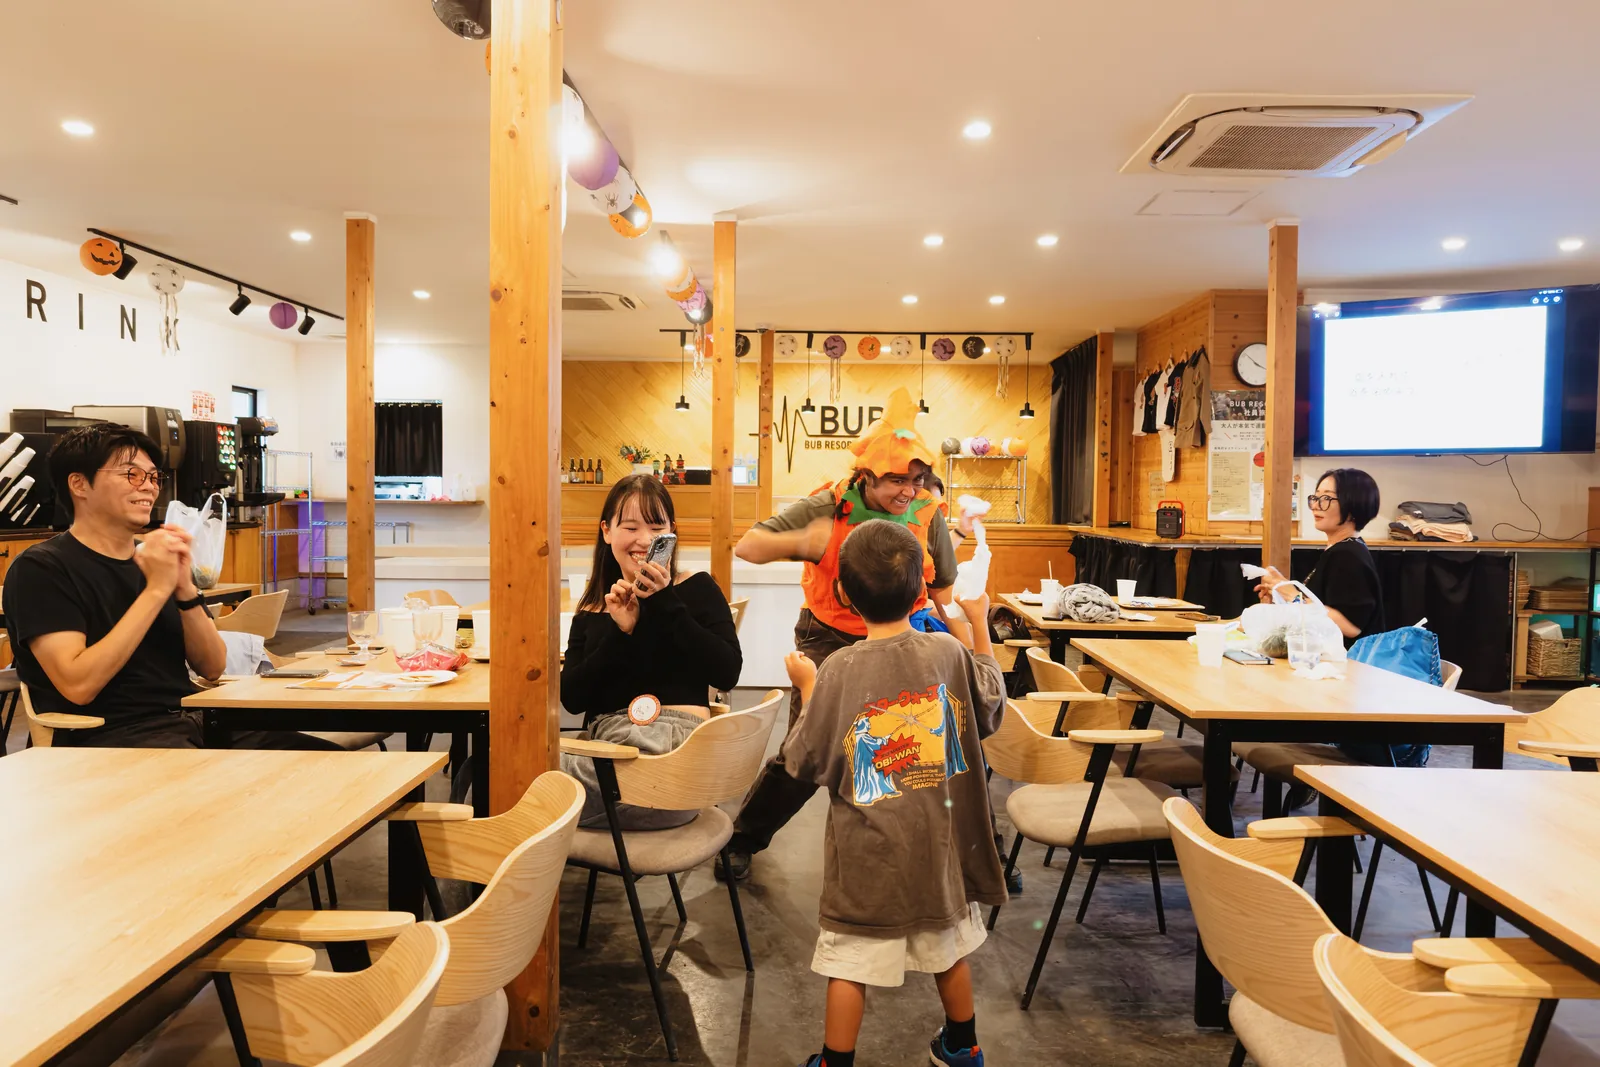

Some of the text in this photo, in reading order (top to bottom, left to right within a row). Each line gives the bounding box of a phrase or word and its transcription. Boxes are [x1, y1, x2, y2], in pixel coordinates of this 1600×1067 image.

[26, 279, 180, 351] RIN
[804, 440, 822, 450] BUB
[875, 744, 920, 769] OBI-WAN
